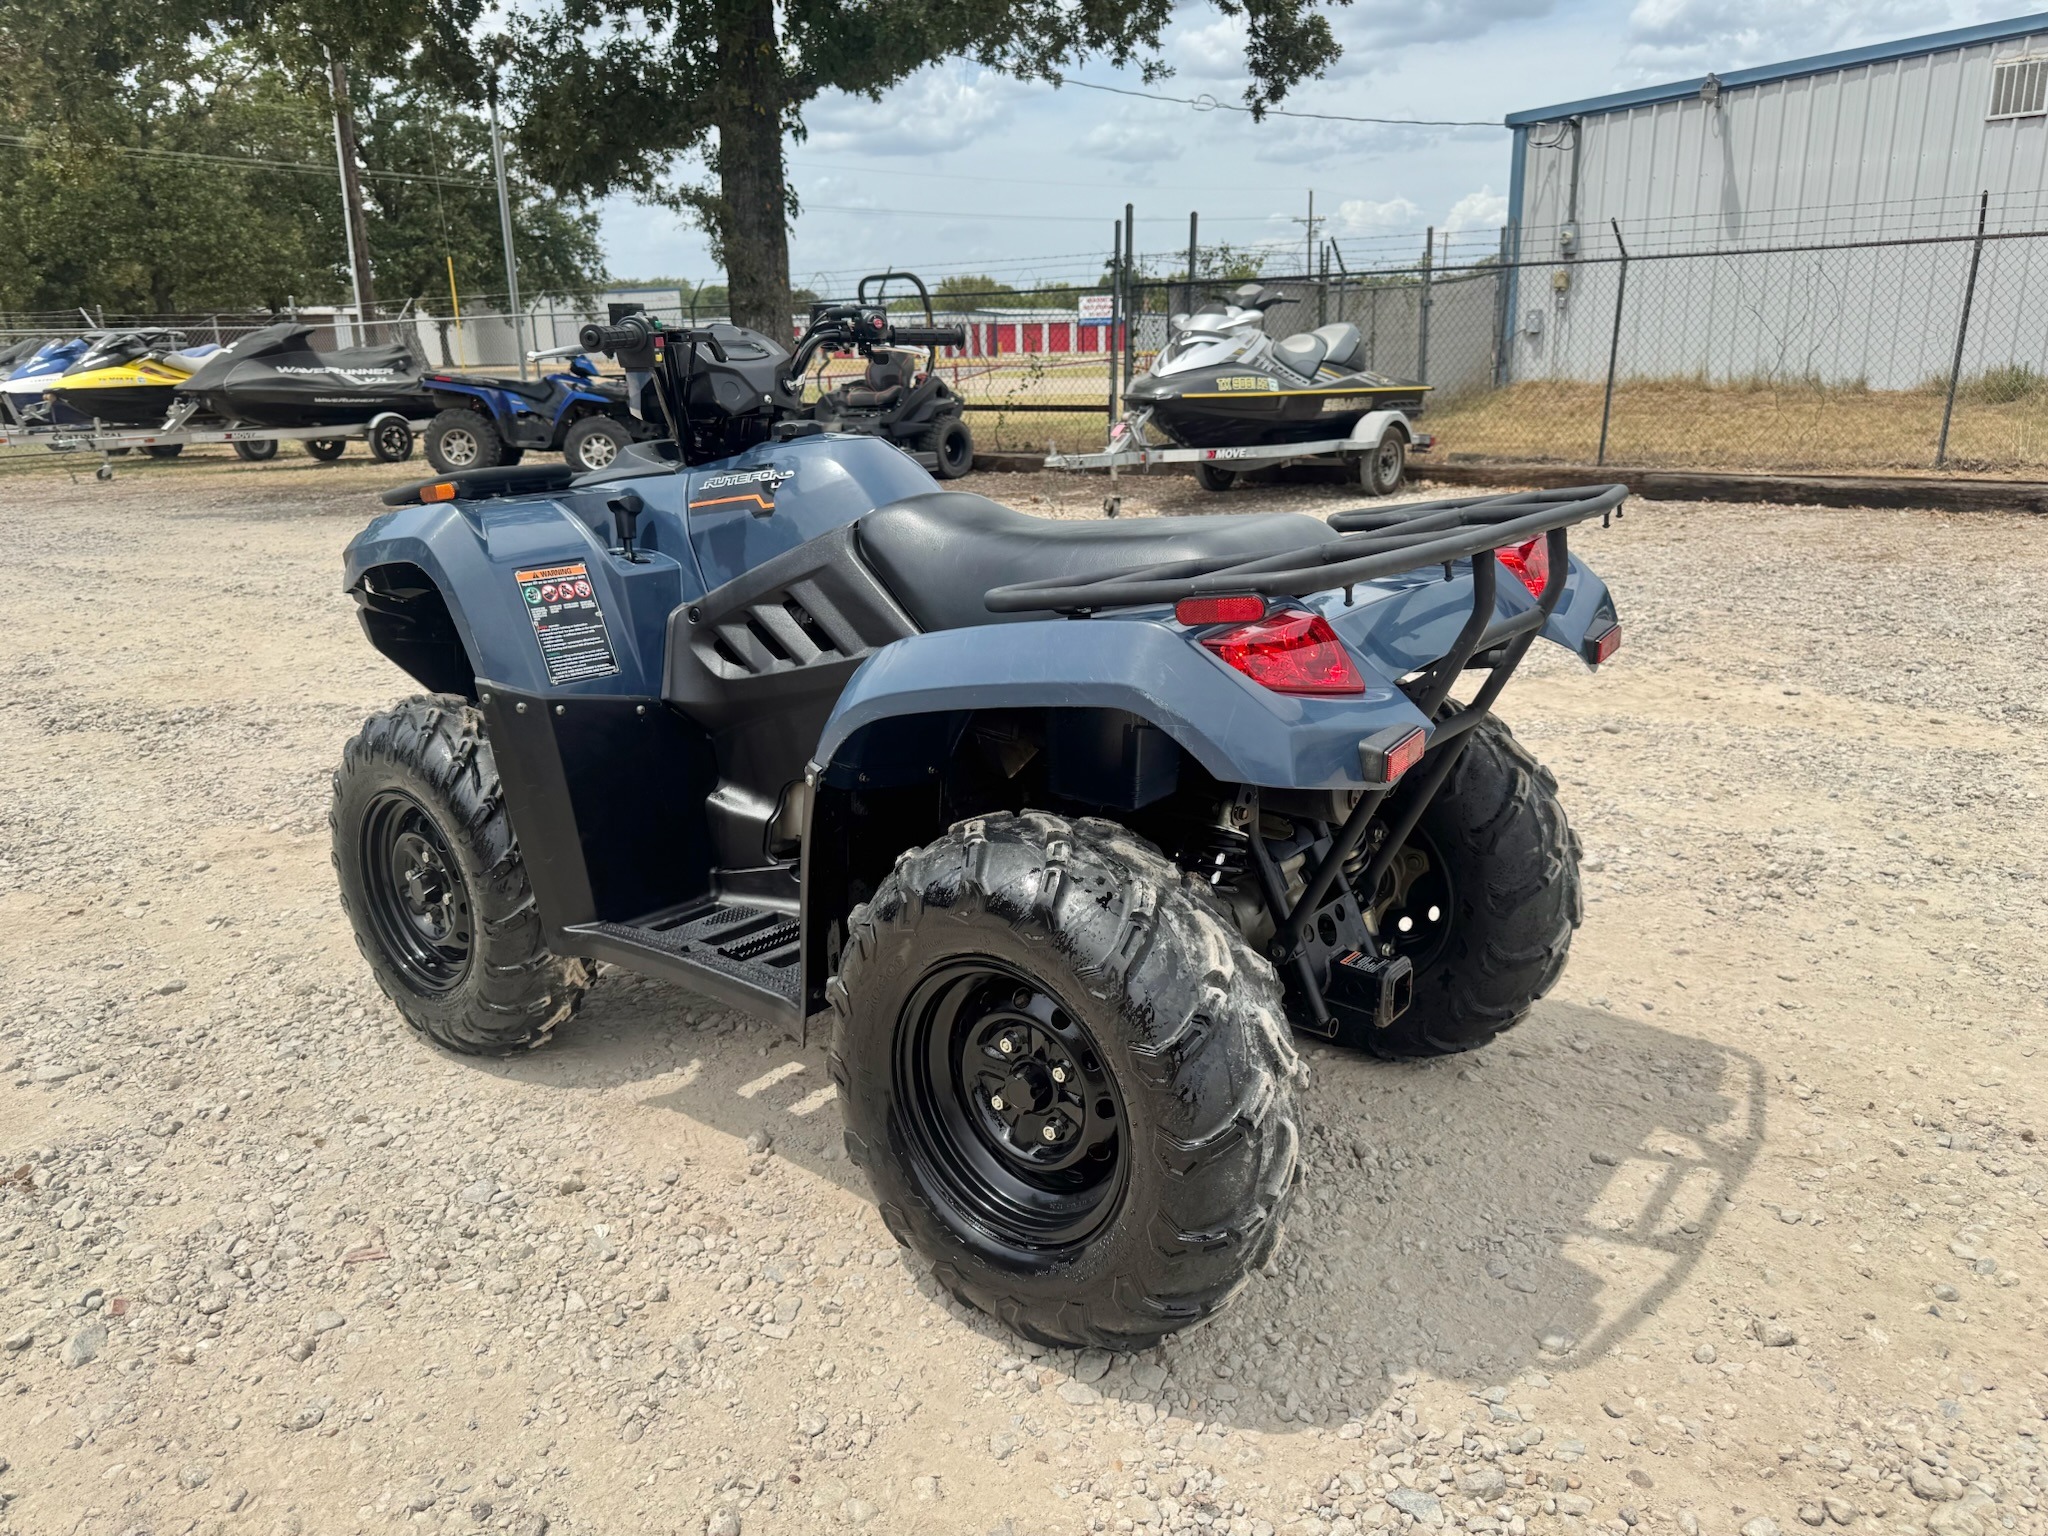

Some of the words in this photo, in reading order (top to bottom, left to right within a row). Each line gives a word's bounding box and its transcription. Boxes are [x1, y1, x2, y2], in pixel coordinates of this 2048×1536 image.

[275, 366, 395, 375] WAVERUNNER
[1216, 377, 1232, 391] TX
[1215, 448, 1246, 459] MOVE
[540, 568, 572, 577] WARNING
